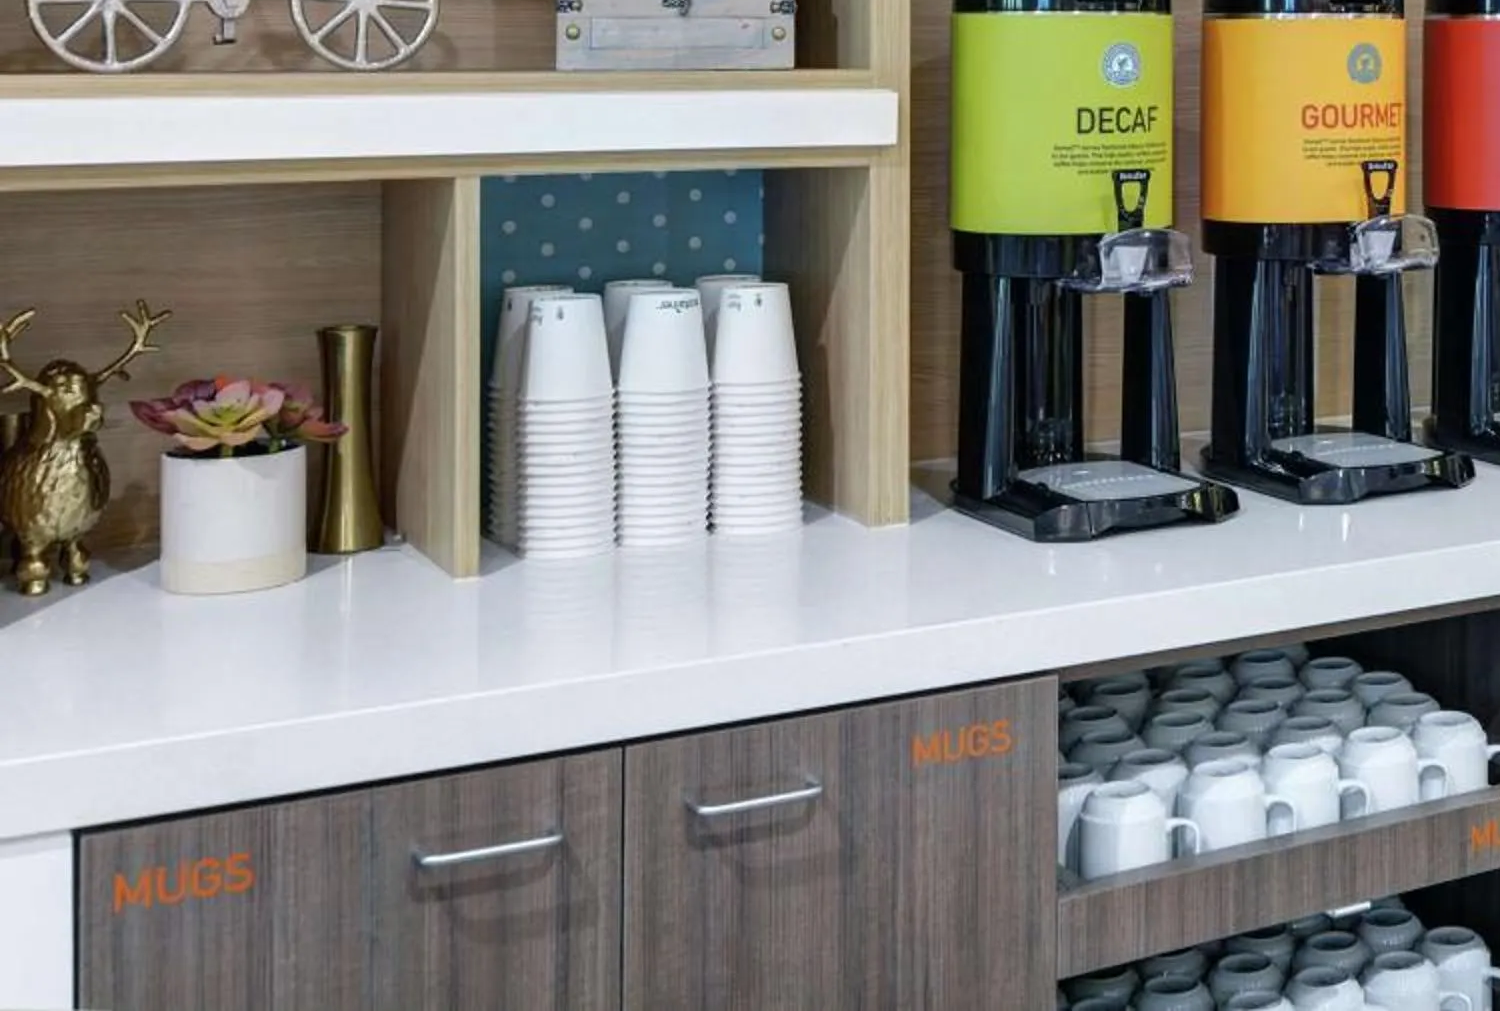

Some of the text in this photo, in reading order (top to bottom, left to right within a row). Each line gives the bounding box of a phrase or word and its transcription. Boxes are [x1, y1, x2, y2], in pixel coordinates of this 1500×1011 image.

[1076, 105, 1159, 134] DECAF
[1301, 102, 1403, 130] GOURMET
[911, 718, 1012, 766] MUGS
[113, 852, 256, 915] MUGS
